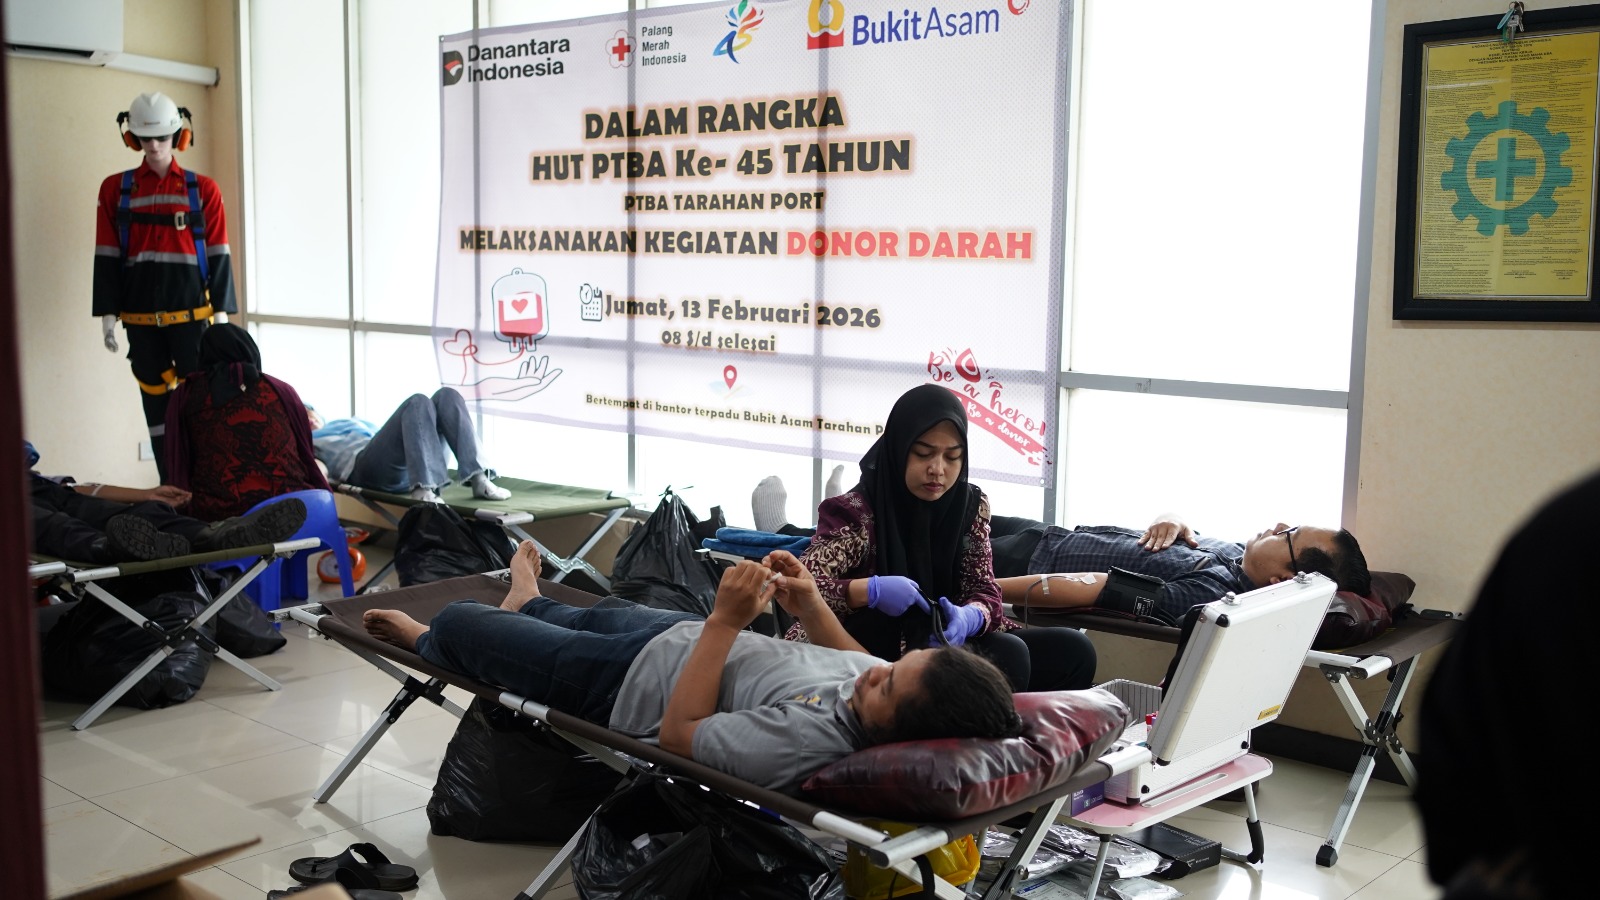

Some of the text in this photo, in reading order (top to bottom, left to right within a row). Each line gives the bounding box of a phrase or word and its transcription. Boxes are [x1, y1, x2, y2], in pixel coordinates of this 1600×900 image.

[642, 25, 673, 38] Palang
[852, 7, 999, 46] BukitAsam
[467, 38, 570, 62] Danantara
[642, 40, 670, 52] Merah
[642, 53, 687, 66] Indonesia
[467, 58, 564, 82] Indonesia
[585, 96, 844, 139] DALAM RANGKA
[532, 139, 911, 181] HUT PTBA Ke- 45 TAHUN
[624, 192, 824, 211] PTBA TARAHAN PORT
[460, 230, 1032, 259] MELAKSANAKAN KEGIATAN DONOR DARAH
[605, 295, 881, 328] Jumat, 13 Februari 2026
[661, 330, 682, 345] 08
[718, 332, 776, 352] selesai
[927, 351, 955, 382] Be
[963, 383, 981, 399] a
[586, 394, 640, 409] Bertempat
[643, 400, 653, 410] di
[656, 402, 692, 414] kantor
[695, 407, 740, 420] terpadu
[743, 411, 777, 424] Bukit
[780, 415, 813, 428] Asam
[816, 418, 871, 434] Tarahan
[967, 401, 1031, 447] Be a donor
